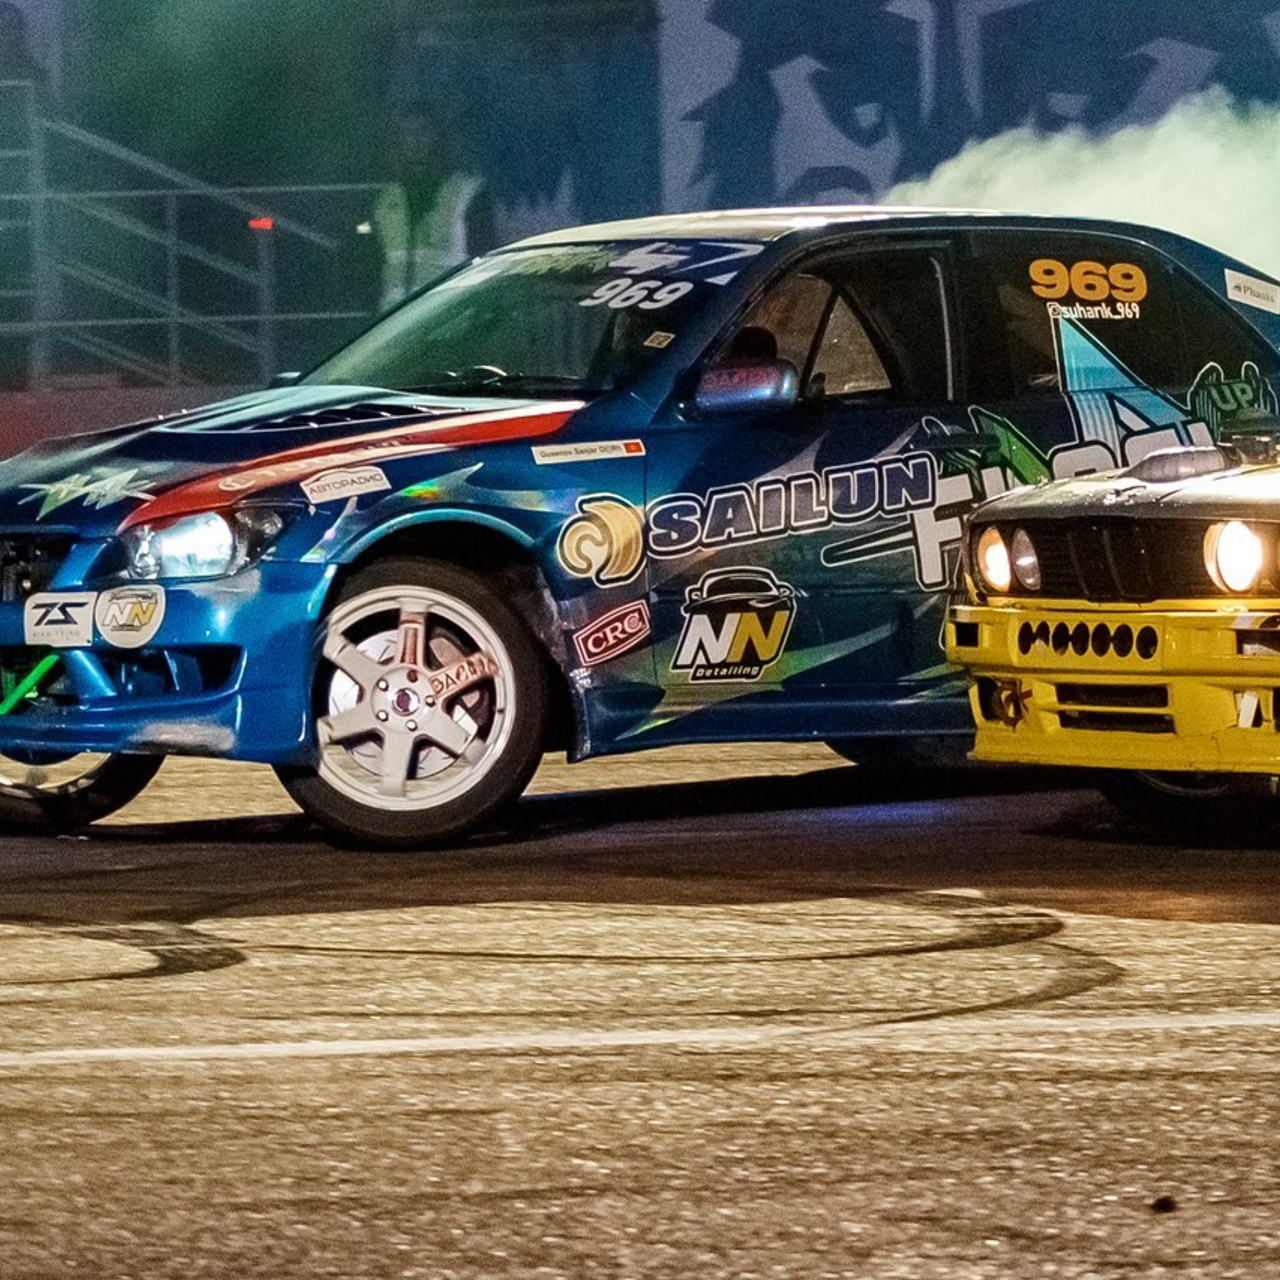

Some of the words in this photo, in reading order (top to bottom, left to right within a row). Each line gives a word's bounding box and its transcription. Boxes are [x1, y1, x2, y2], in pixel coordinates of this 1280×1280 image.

[578, 277, 694, 310] 969
[1029, 258, 1148, 302] 969
[1209, 382, 1254, 411] UP
[309, 473, 384, 496] АВТОРАДИО
[647, 454, 935, 556] SAILUN
[587, 612, 643, 653] CRC
[676, 609, 790, 666] NN
[696, 665, 760, 677] Detailing
